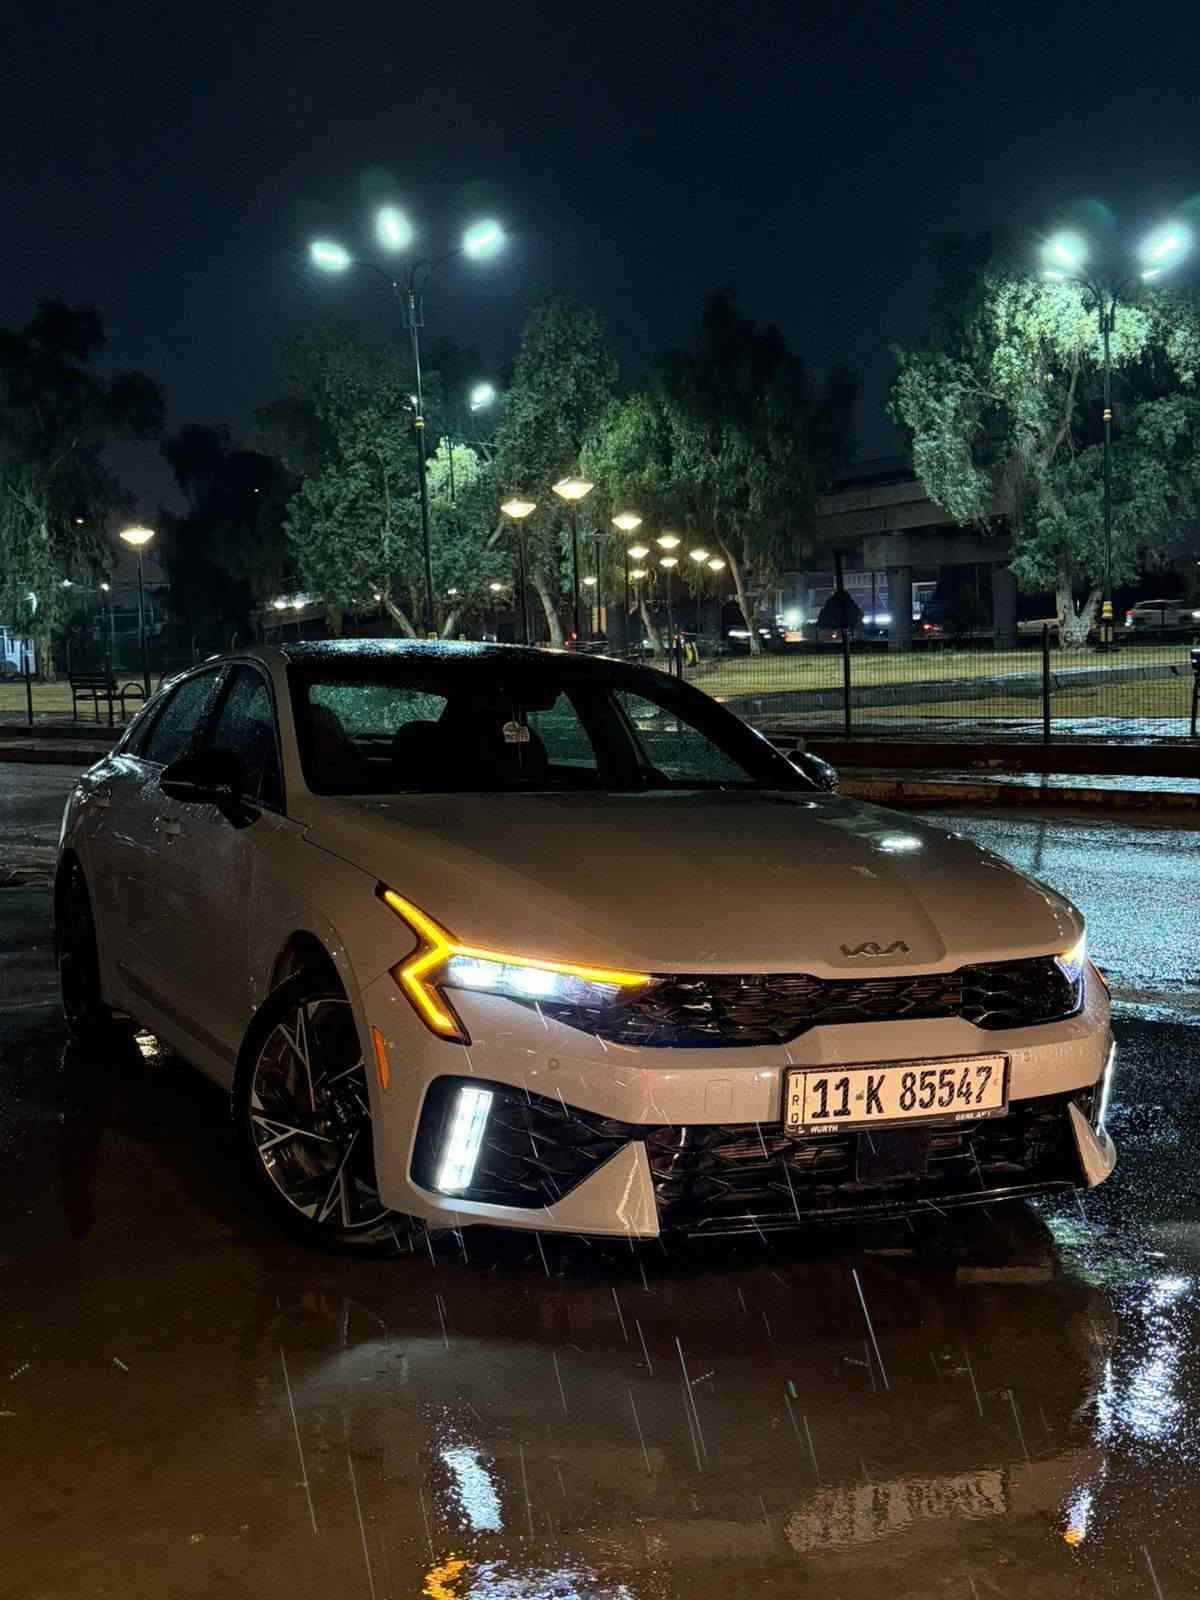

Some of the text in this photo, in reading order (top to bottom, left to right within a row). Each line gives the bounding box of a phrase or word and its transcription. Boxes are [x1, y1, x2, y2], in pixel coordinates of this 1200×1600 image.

[840, 941, 910, 957] KIA
[812, 1066, 992, 1118] 11 K 85547
